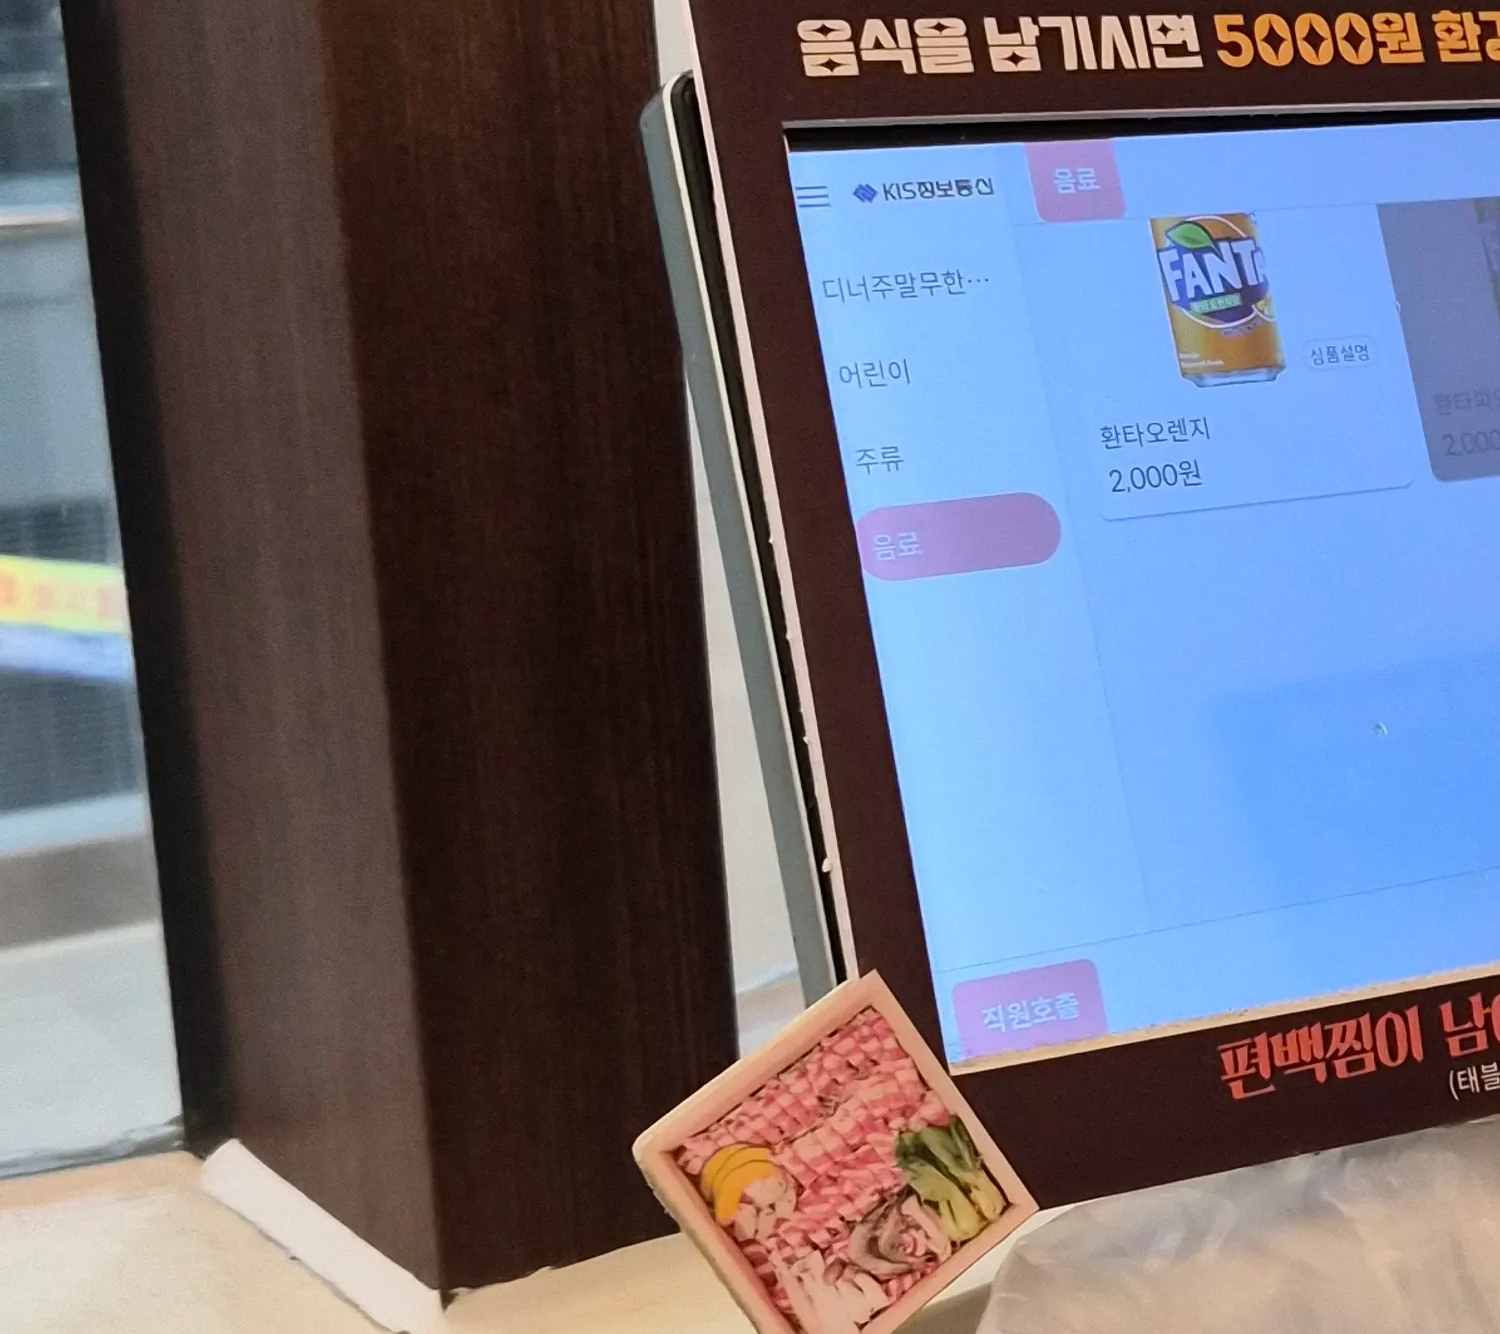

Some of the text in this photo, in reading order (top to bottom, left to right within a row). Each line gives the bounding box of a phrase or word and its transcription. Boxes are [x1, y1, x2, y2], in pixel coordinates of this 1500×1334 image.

[796, 17, 975, 77] 음식을
[982, 14, 1204, 74] 남기시면
[1213, 11, 1425, 68] 5000원
[883, 177, 995, 202] KIS정보통신
[1053, 166, 1100, 195] 음료
[839, 358, 911, 389] 어린이
[1100, 416, 1211, 450] 환타오렌지
[855, 445, 905, 475] 주류
[1108, 458, 1204, 493] 2,000원
[873, 531, 923, 561] 음료
[980, 991, 1080, 1034] 직원호출
[1216, 1004, 1425, 1101] 편백찜이
